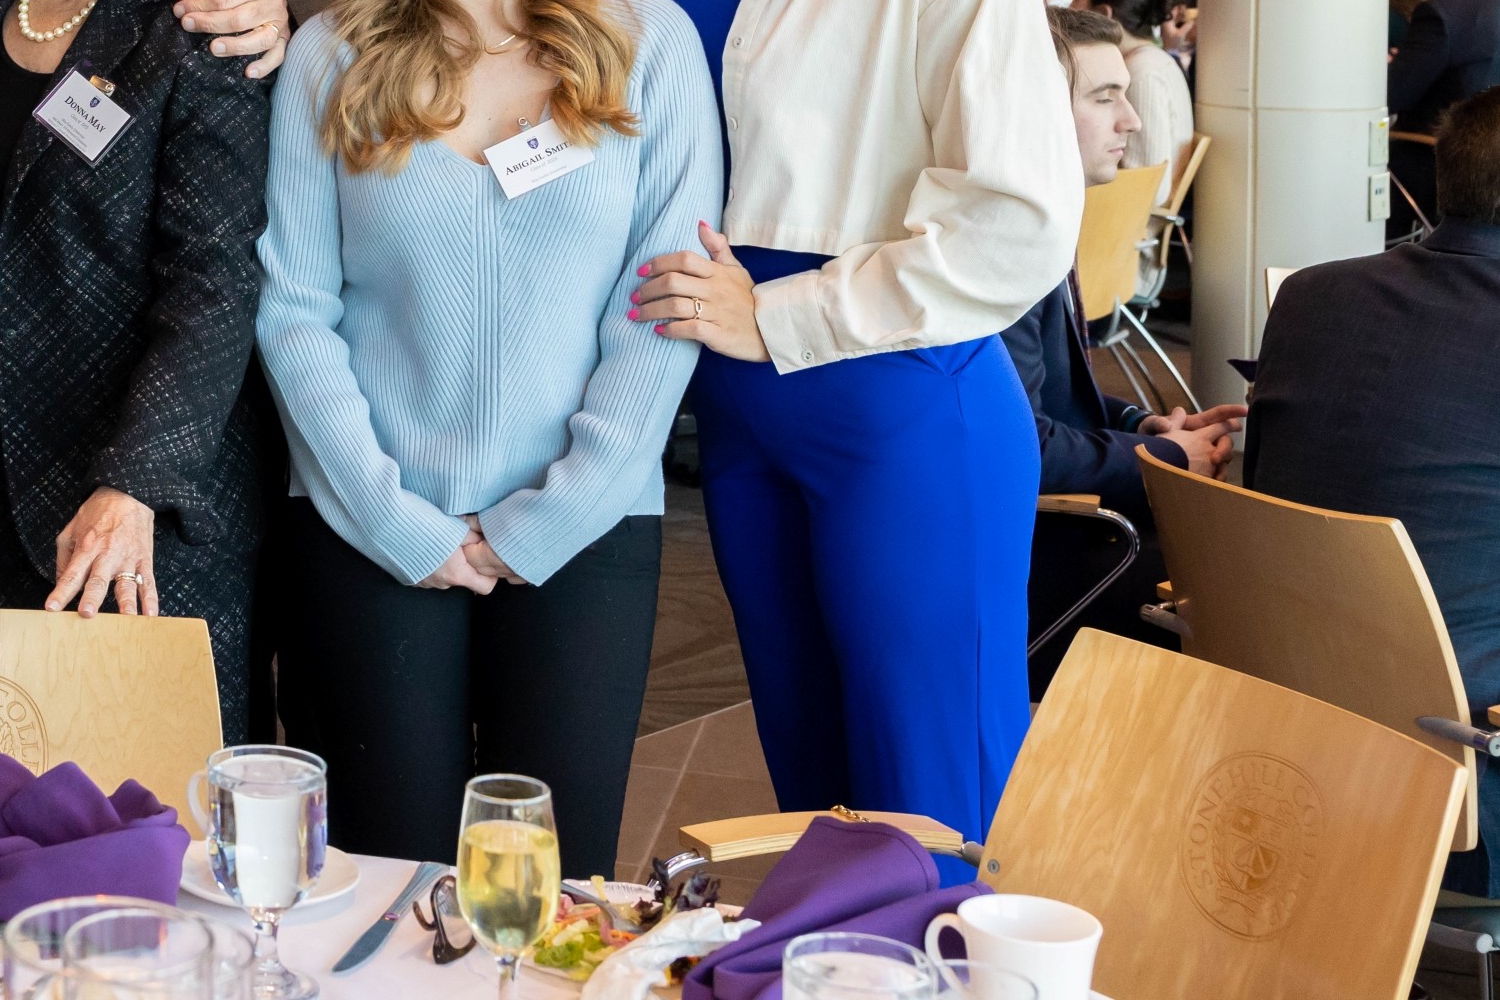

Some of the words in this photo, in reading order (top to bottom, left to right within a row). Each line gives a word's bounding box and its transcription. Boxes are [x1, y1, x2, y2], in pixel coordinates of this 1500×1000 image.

[64, 96, 88, 120] DONNA
[88, 115, 106, 133] MAY
[505, 154, 544, 175] ABIGAIL
[1189, 763, 1283, 889] STONEHILL
